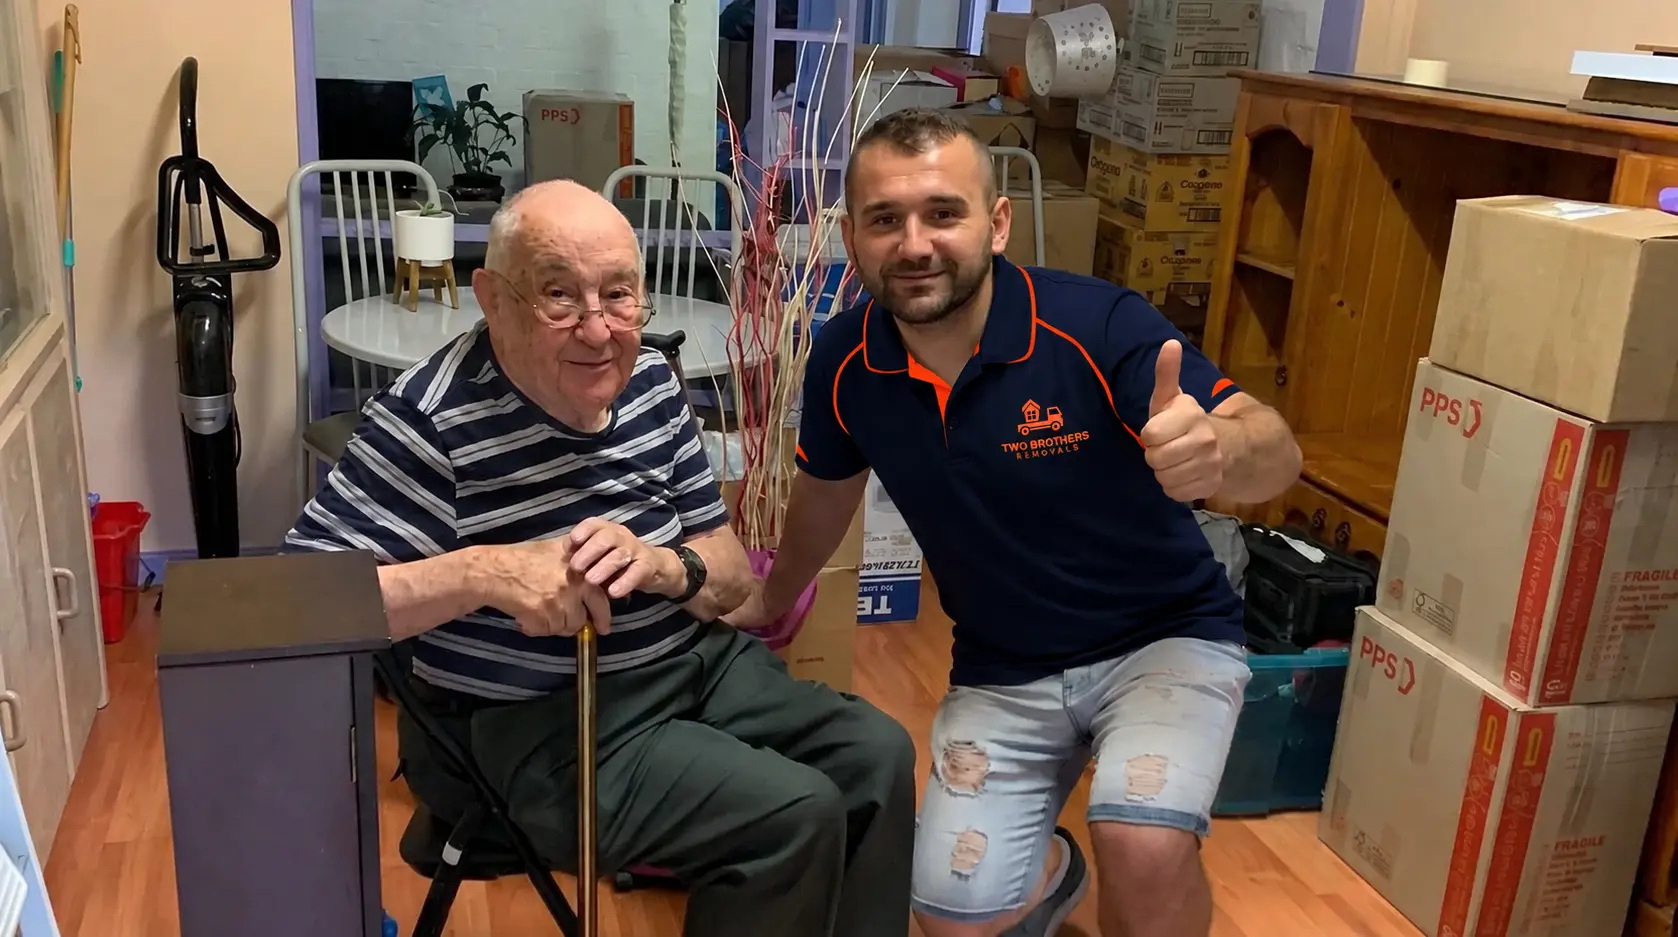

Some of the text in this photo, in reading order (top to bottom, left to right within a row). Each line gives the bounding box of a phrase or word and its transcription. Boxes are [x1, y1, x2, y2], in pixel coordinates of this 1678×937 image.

[1001, 430, 1090, 453] TWO BROTHERS
[1016, 443, 1079, 461] REMOVALS
[1624, 568, 1678, 582] FRAGILE
[1554, 834, 1606, 852] FRAGILE
